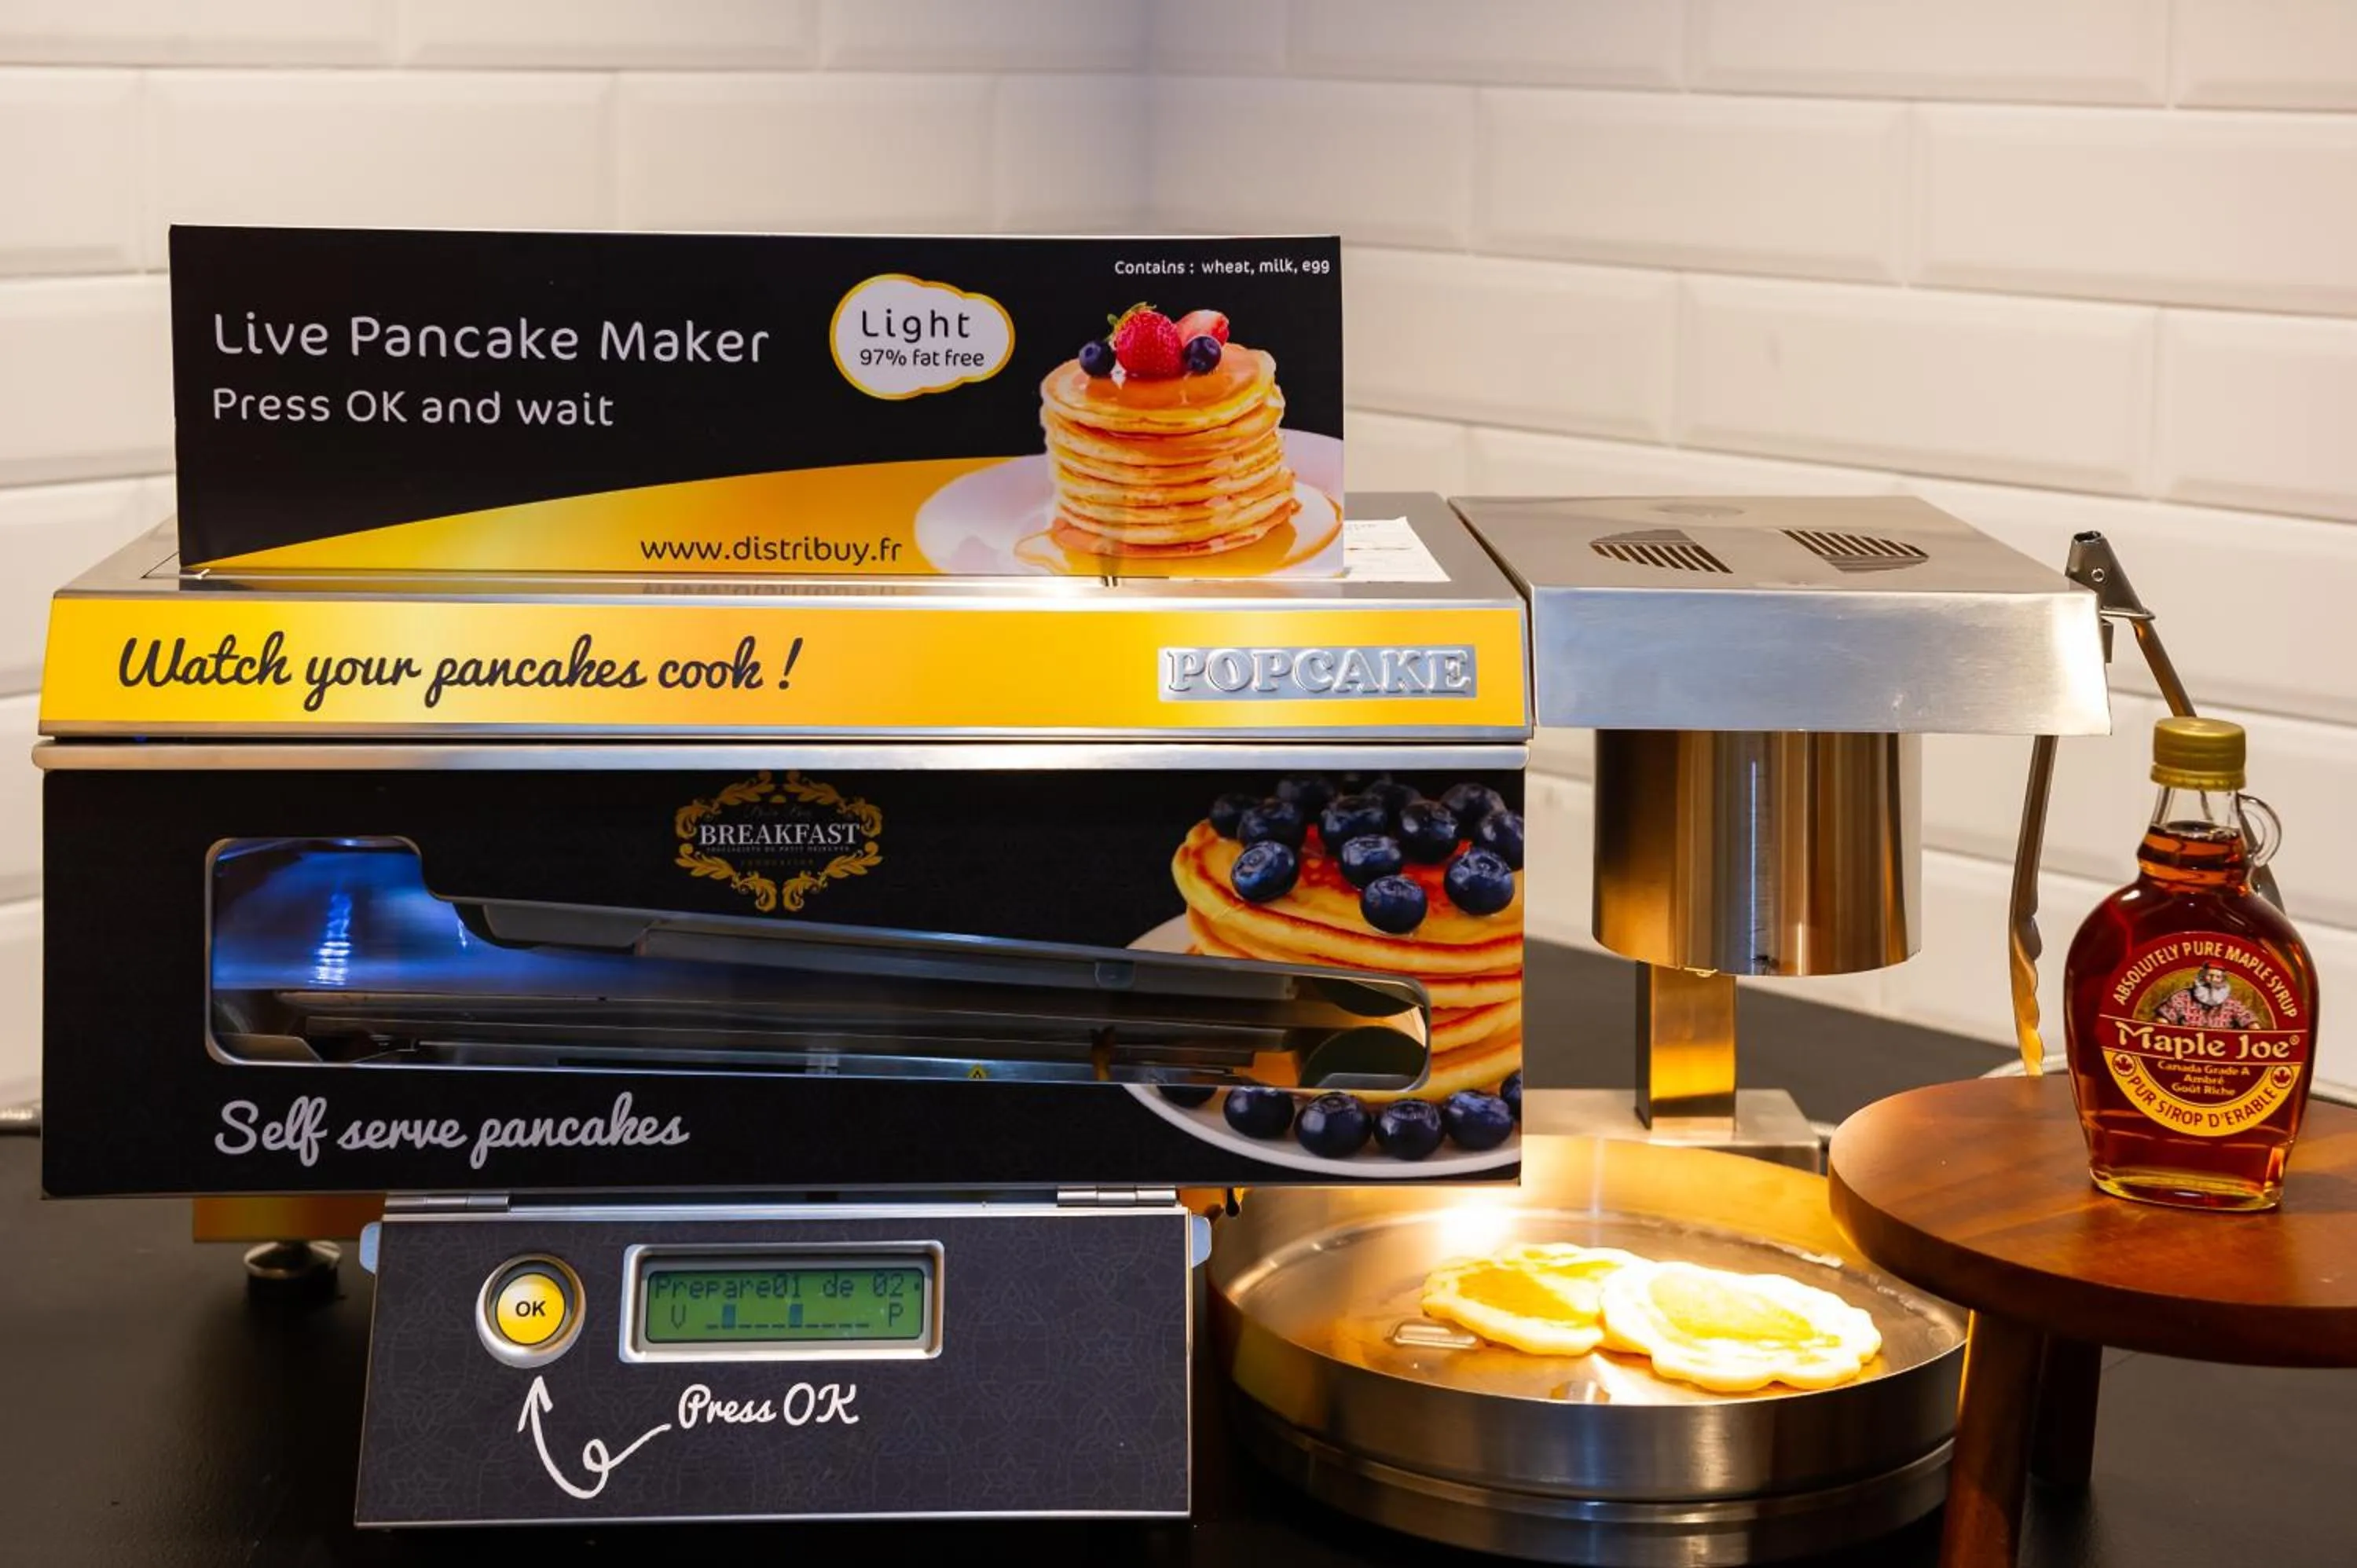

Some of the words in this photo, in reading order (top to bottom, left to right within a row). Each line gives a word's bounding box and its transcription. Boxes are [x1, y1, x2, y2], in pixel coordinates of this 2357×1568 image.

[1114, 260, 1186, 275] Contains
[1201, 259, 1255, 276] wheat,
[1259, 258, 1297, 275] milk,
[1301, 260, 1331, 274] egg
[214, 311, 329, 356] Live
[350, 316, 579, 361] Pancake
[599, 321, 770, 363] Maker
[861, 308, 970, 344] Light
[860, 348, 907, 366] 97%
[912, 348, 940, 366] fat
[945, 349, 985, 367] free
[213, 387, 331, 422] Press
[346, 390, 409, 423] OK
[422, 391, 500, 425] and
[516, 392, 615, 427] wait
[640, 536, 903, 566] www.distribuy.fr
[118, 629, 292, 689] Watch
[302, 655, 423, 713] your
[423, 632, 648, 709] pancakes
[658, 635, 764, 691] cook
[1166, 648, 1472, 694] POPCAKE
[698, 823, 860, 845] BREAKFAST
[2112, 945, 2181, 1006] ABSOLUTELY
[2182, 940, 2223, 958] PURE
[2224, 946, 2271, 982] MAPLE
[2267, 975, 2298, 1019] SYRUP
[2114, 1021, 2226, 1060] Maple
[2157, 1061, 2202, 1075] Canada
[2203, 1064, 2239, 1076] Grade
[2240, 1066, 2251, 1076] A
[2128, 1075, 2157, 1107] PUR
[2155, 1100, 2203, 1128] SIROP
[2208, 1086, 2278, 1128] D'ERABLE
[2203, 1083, 2236, 1096] Riche
[214, 1095, 328, 1168] Self
[336, 1117, 467, 1151] serve
[469, 1090, 691, 1171] pancakes
[822, 1273, 854, 1299] de
[872, 1273, 905, 1298] 02
[515, 1299, 547, 1320] OK
[887, 1302, 904, 1328] P
[678, 1383, 776, 1430] Press
[783, 1382, 860, 1427] OK
